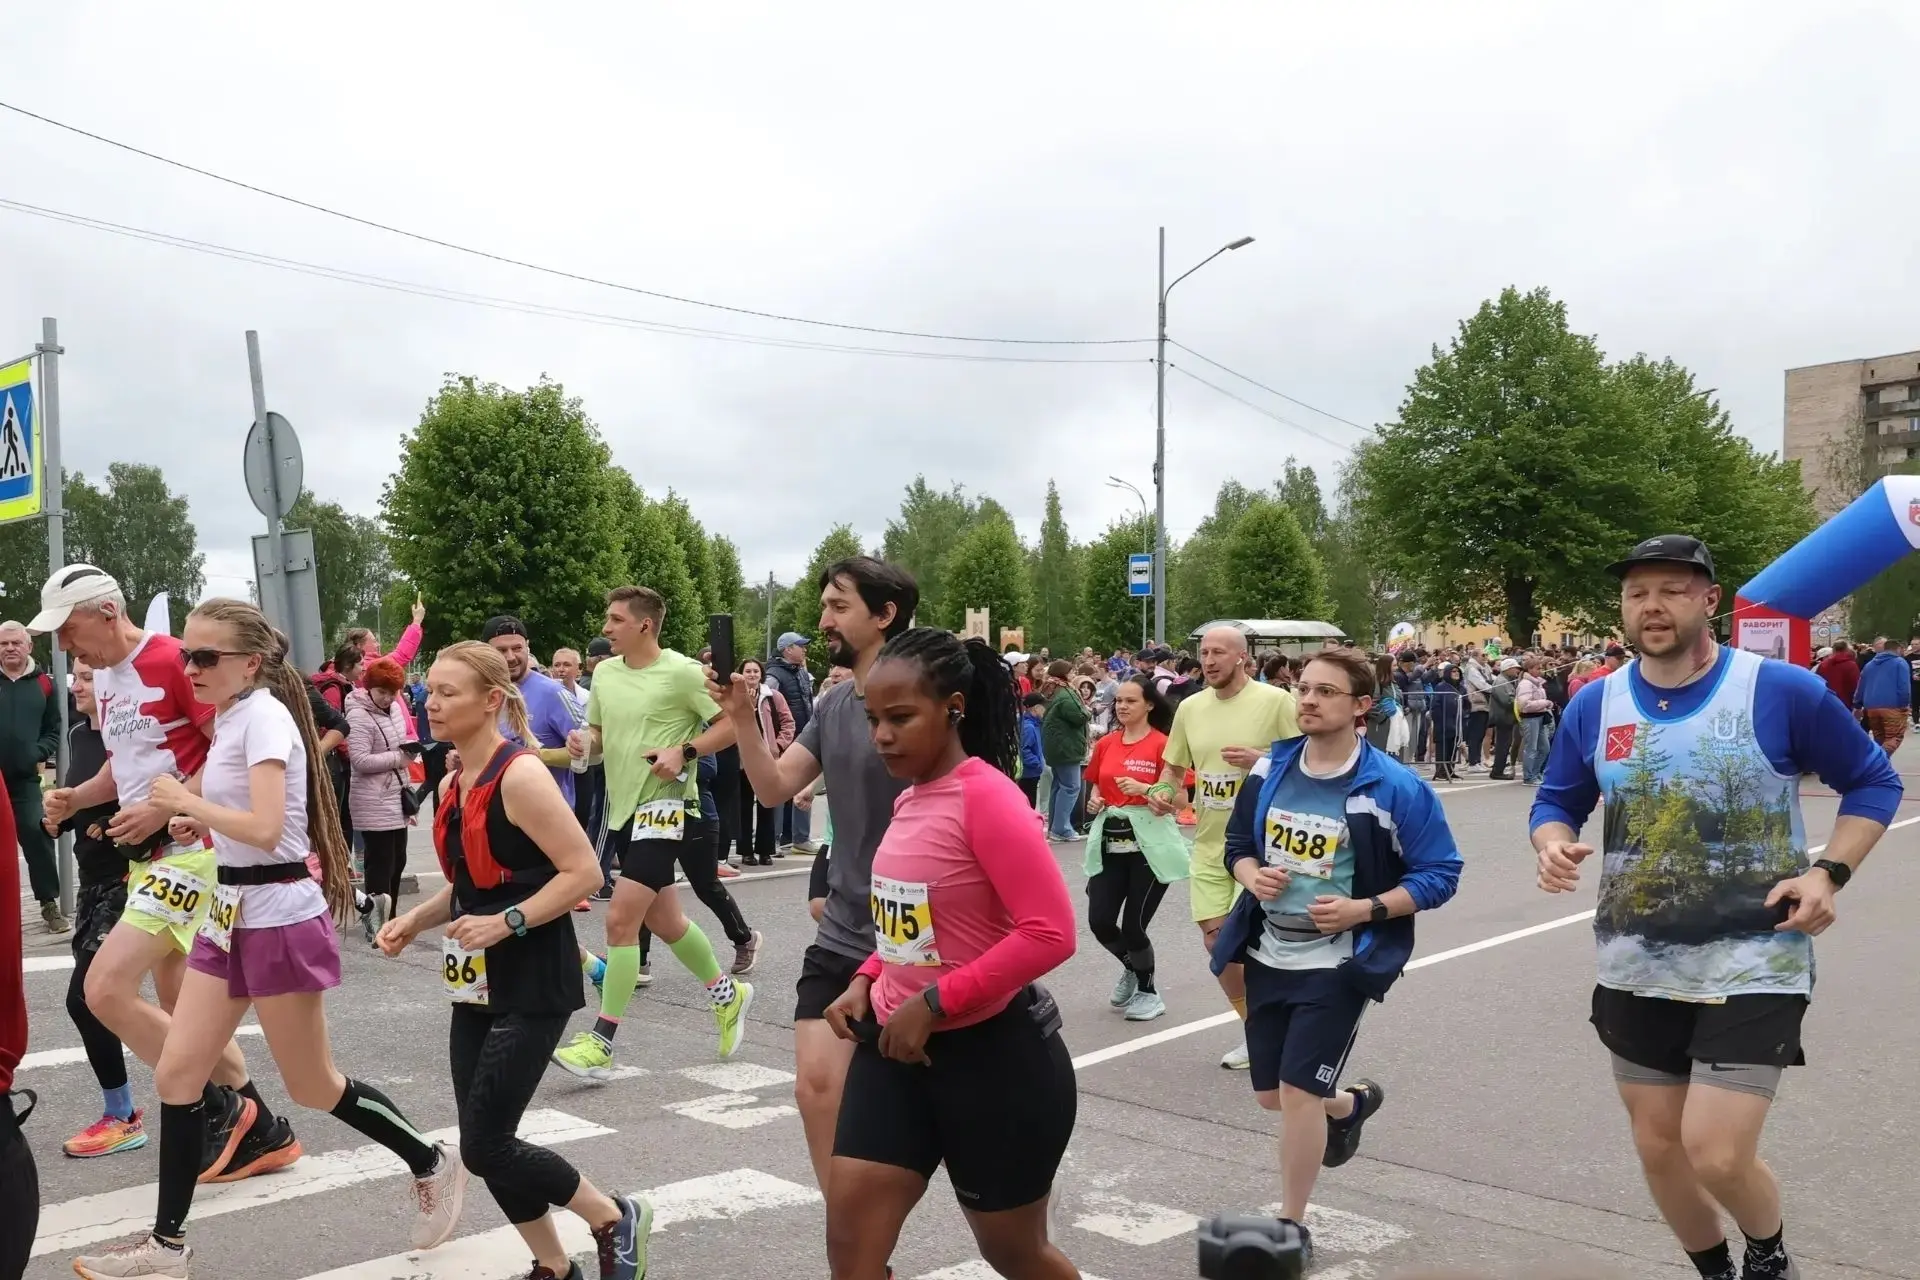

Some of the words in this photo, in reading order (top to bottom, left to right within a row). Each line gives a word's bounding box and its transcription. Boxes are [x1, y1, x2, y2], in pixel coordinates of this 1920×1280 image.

[1123, 759, 1156, 768] ДОНОРЫ
[1126, 766, 1156, 775] РОССИИ
[1203, 780, 1236, 798] 2147
[638, 809, 679, 830] 2144
[1271, 823, 1327, 859] 2138
[138, 874, 200, 913] 2350
[873, 895, 920, 941] 2175
